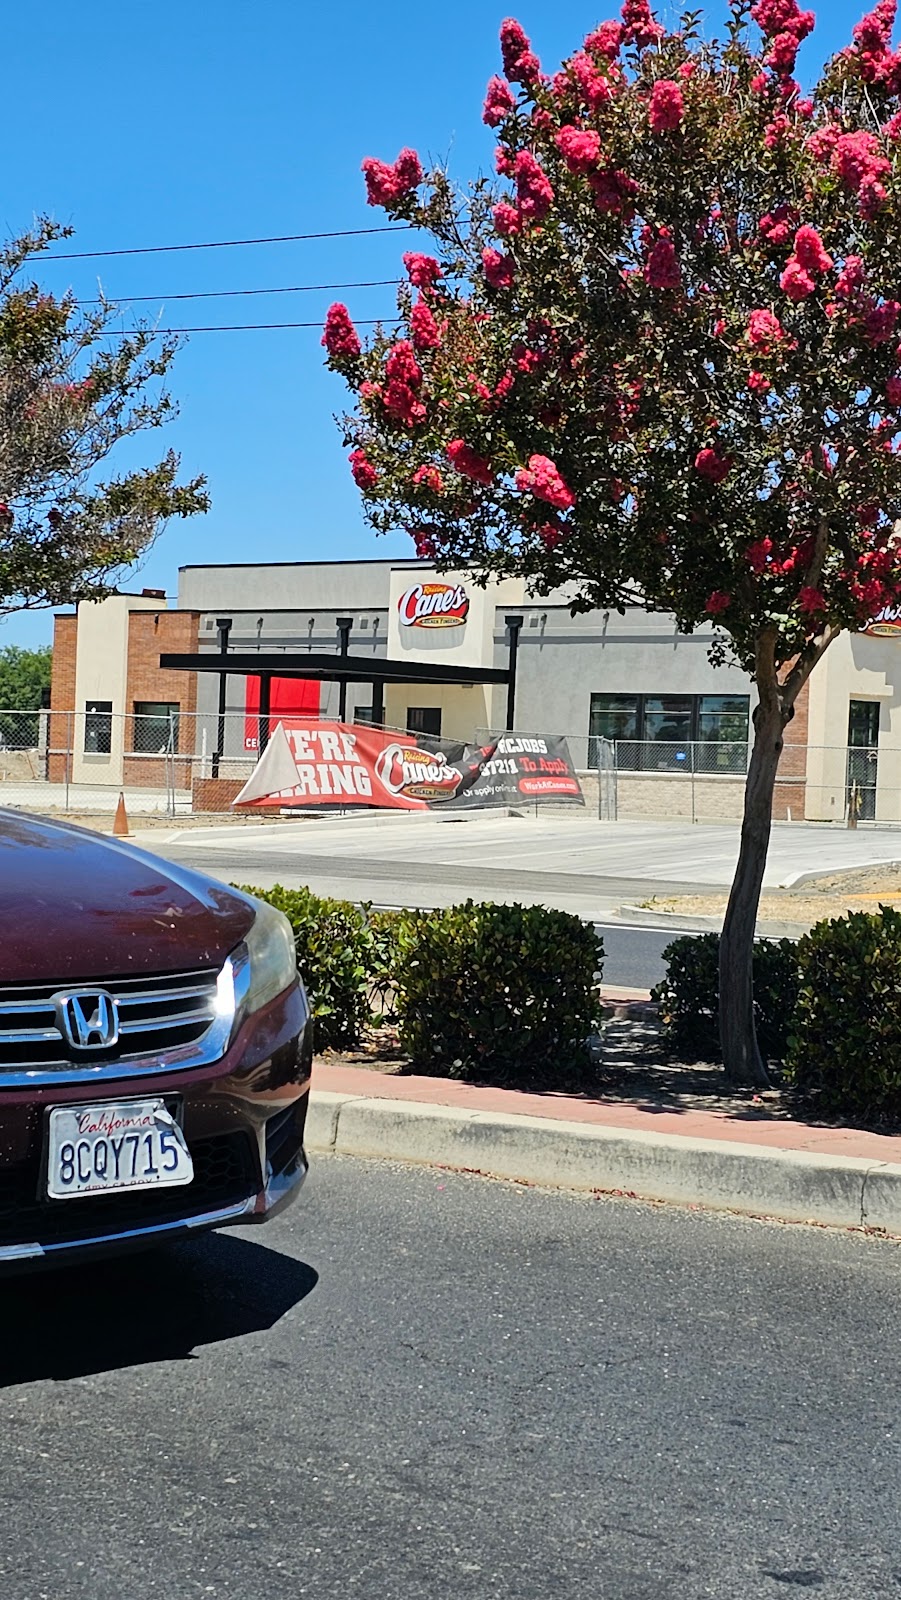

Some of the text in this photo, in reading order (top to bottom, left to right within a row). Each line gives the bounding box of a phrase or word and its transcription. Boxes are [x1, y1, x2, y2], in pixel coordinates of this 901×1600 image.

[400, 583, 467, 625] Cane's
[423, 585, 447, 595] Raising
[283, 730, 361, 763] E'RE
[403, 751, 430, 764] Raising
[269, 764, 373, 797] RING
[381, 744, 456, 793] Cane's
[519, 757, 537, 772] To
[539, 757, 568, 775] Apply
[475, 783, 495, 797] apply
[78, 1112, 158, 1137] California
[60, 1131, 179, 1186] 8CQY715
